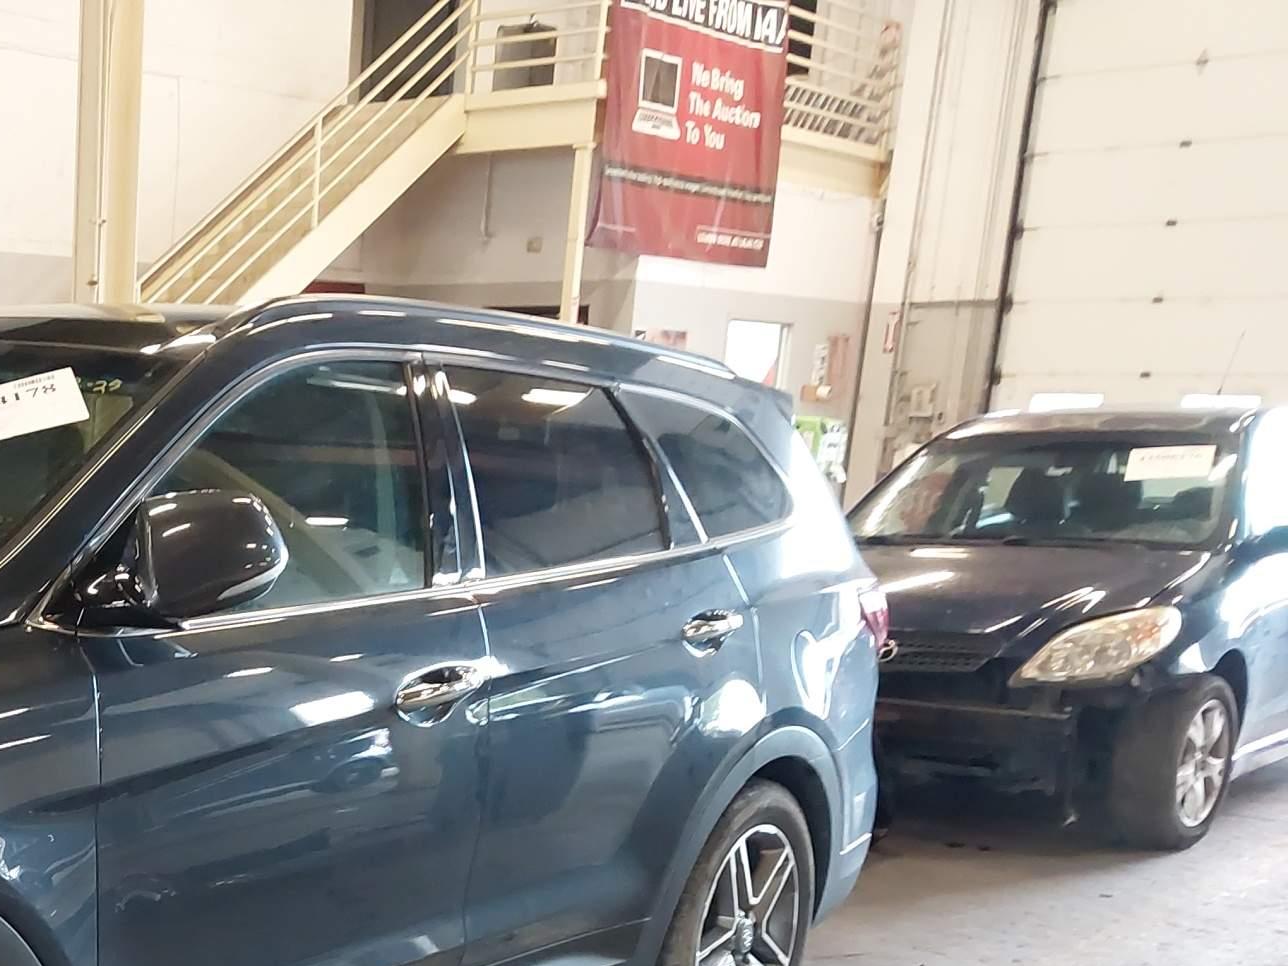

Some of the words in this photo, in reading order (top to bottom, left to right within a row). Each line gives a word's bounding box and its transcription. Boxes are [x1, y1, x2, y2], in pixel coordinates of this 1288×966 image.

[708, 0, 753, 38] FROM
[692, 61, 710, 88] We
[710, 67, 745, 102] Bring
[689, 91, 711, 117] The
[712, 97, 761, 129] Auction
[685, 119, 700, 144] To
[703, 123, 725, 150] You
